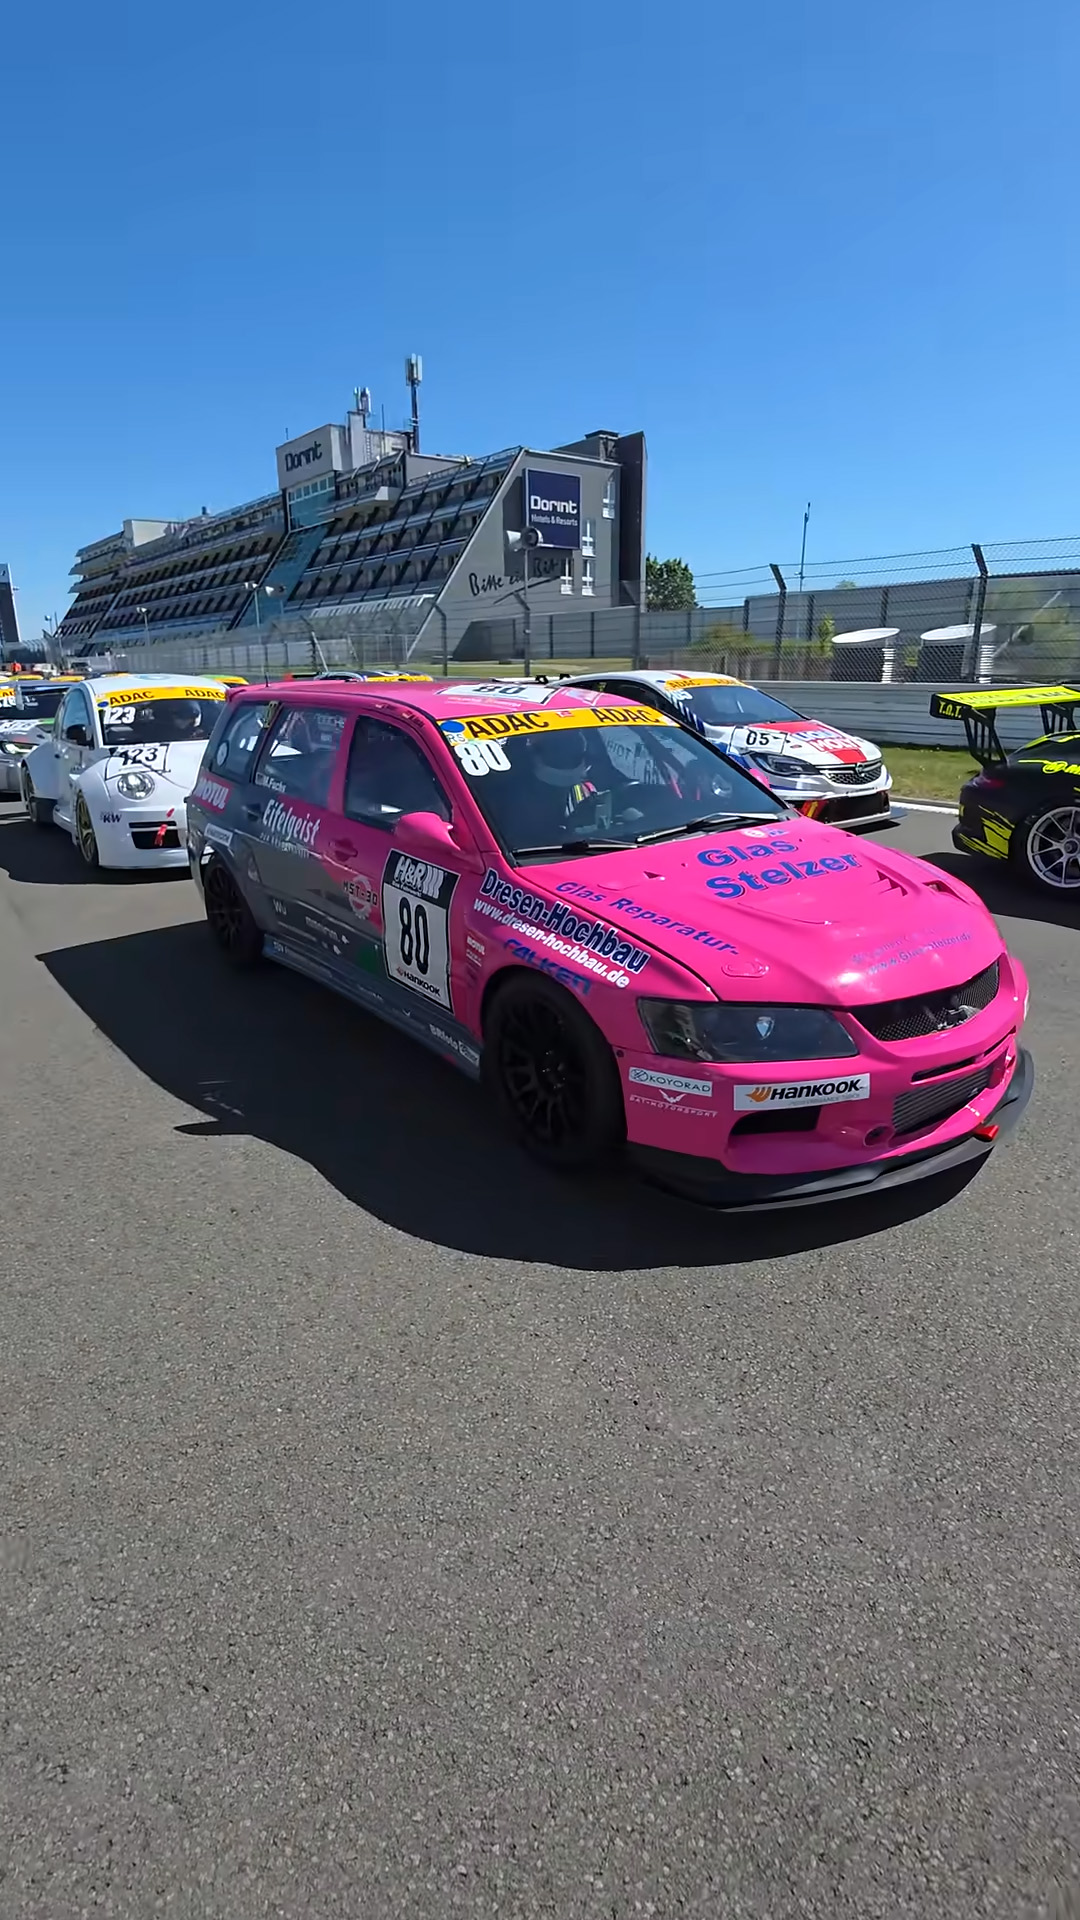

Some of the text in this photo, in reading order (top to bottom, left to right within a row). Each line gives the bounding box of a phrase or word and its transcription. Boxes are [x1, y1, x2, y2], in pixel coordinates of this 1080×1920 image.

[285, 440, 322, 472] Dorint
[530, 495, 578, 514] Dorint
[531, 513, 551, 524] Hotels
[556, 516, 578, 526] Resorts
[469, 573, 504, 596] Bitte
[109, 690, 155, 706] ADAC
[184, 689, 226, 700] ADAC
[472, 685, 526, 695] 80
[103, 706, 136, 725] 123
[465, 712, 549, 739] ADAC
[592, 708, 661, 724] ADAC
[120, 747, 159, 766] 123
[454, 740, 511, 777] 80
[194, 777, 229, 809] MOTUL
[103, 814, 121, 823] KW
[262, 798, 320, 845] Eifelgeist
[697, 840, 798, 867] Glas
[394, 856, 427, 892] H&R
[705, 853, 863, 898] Stelzer
[479, 867, 651, 975] Dresen-Hochbau
[555, 881, 740, 956] Glas Reparatur-
[399, 897, 429, 975] 80
[473, 897, 630, 989] www.dresen-hochbau.de
[503, 938, 593, 996] FALKEN
[649, 1075, 711, 1093] KOYORAD
